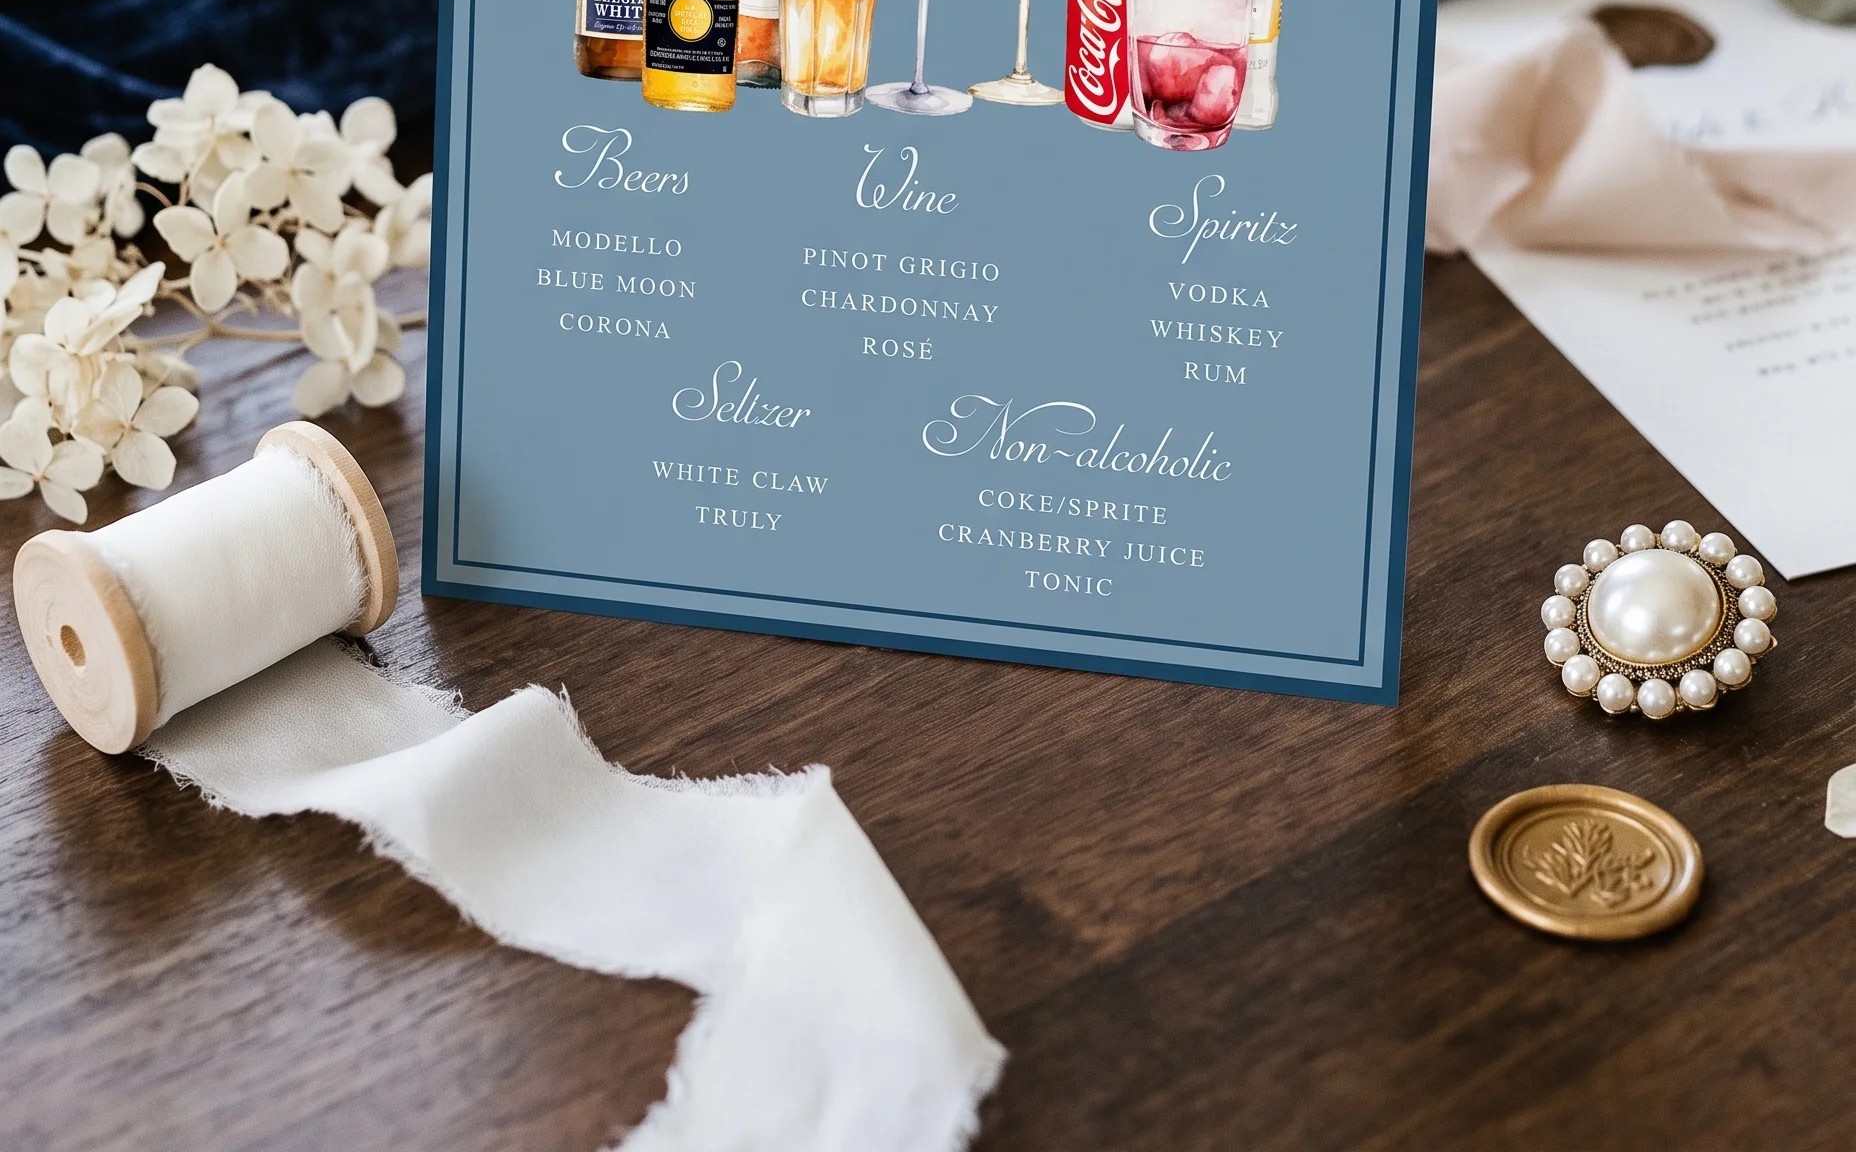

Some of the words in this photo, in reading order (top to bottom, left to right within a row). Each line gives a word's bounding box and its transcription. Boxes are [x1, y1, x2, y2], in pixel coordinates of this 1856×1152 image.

[594, 2, 643, 19] WHIT
[554, 124, 689, 195] Beers
[855, 143, 959, 214] Wine
[1148, 174, 1298, 265] Spiritz
[551, 229, 682, 257] MODELLO
[802, 247, 887, 272] PINOT
[899, 255, 1000, 282] GRIGIO
[536, 268, 604, 291] BLUE
[615, 274, 697, 299] MOON
[1168, 281, 1271, 309] VODKA
[801, 288, 999, 323] CHARDONNAY
[559, 312, 671, 340] CORONA
[1149, 319, 1285, 349] WHISKEY
[862, 336, 933, 361] ROSÉ
[1184, 361, 1247, 385] RUM
[671, 360, 811, 428] Seltzer
[651, 460, 740, 486] WHITE
[752, 470, 829, 495] CLAW
[695, 505, 783, 531] TRULY
[978, 489, 1167, 525] COKE/SPRITE
[938, 523, 1112, 558] CRANBERRY
[1123, 542, 1205, 568] JUICE
[1024, 570, 1112, 597] TONIC
